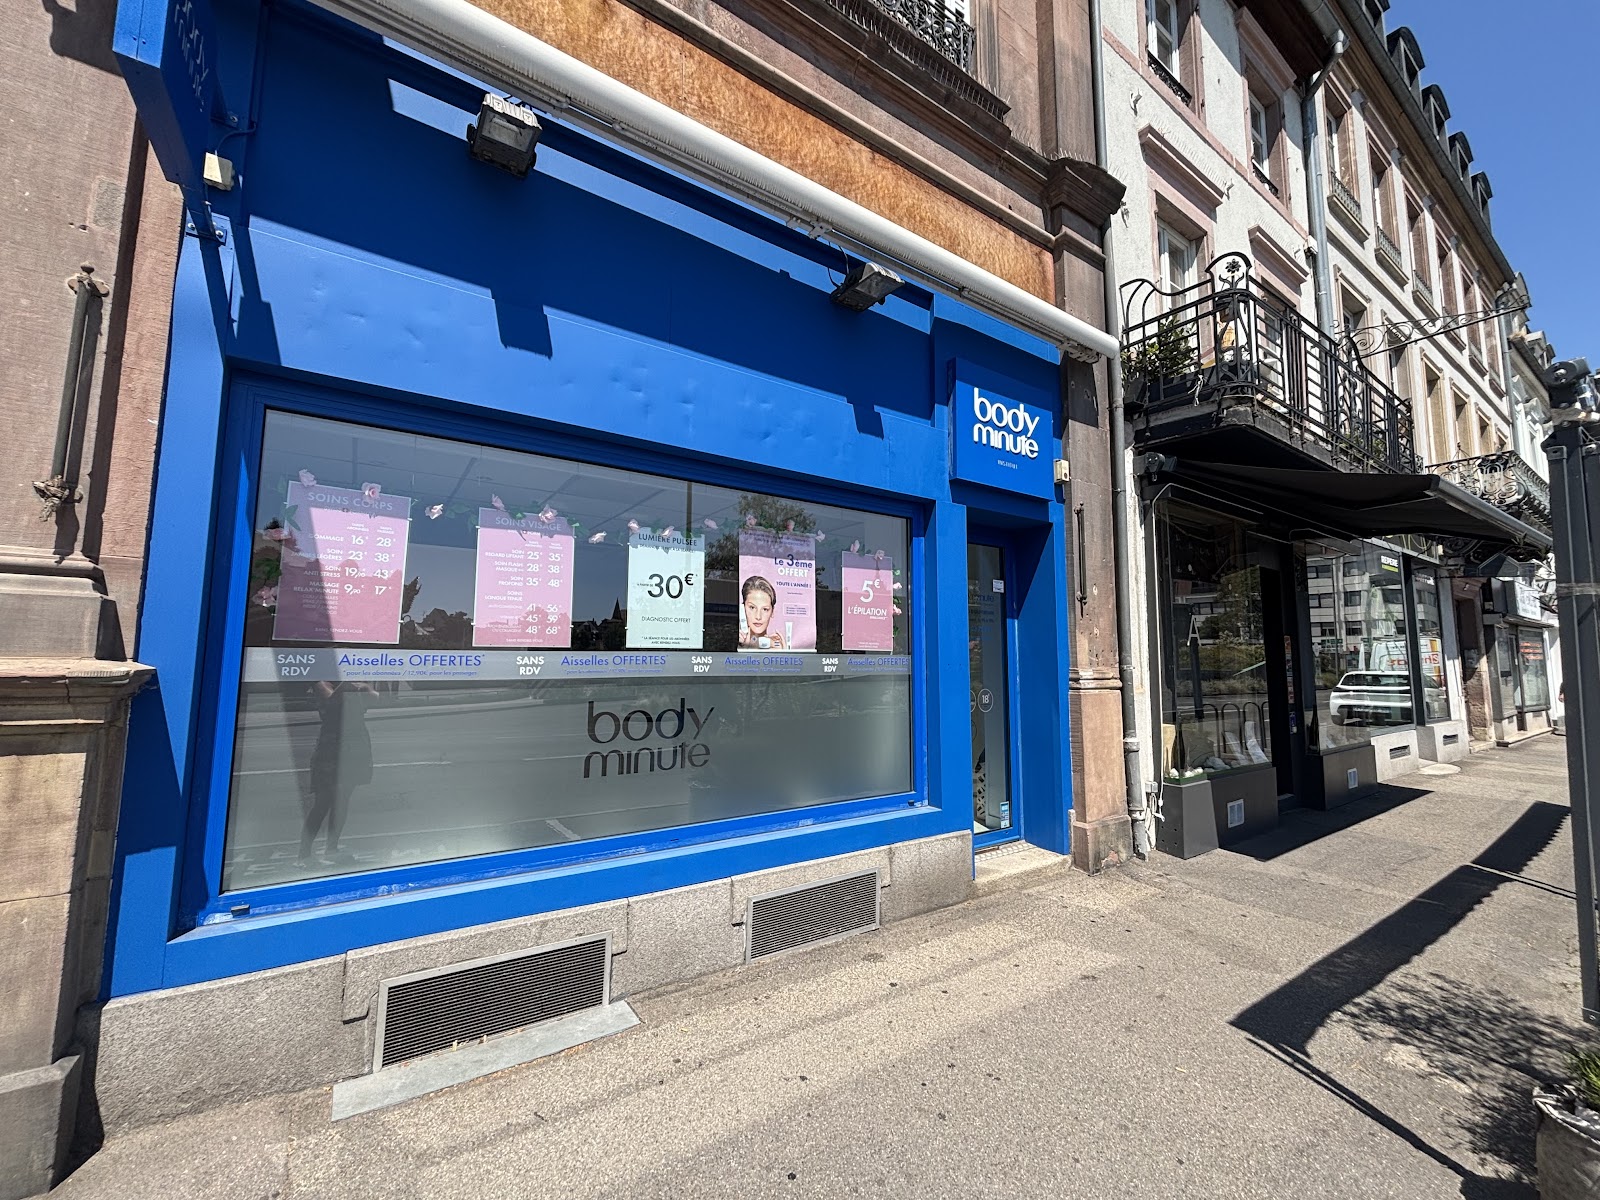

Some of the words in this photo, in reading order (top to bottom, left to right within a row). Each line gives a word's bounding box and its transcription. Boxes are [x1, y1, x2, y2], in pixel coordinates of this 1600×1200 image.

[974, 386, 1040, 438] body
[973, 423, 1038, 458] minute
[308, 492, 349, 505] SOINS
[353, 498, 393, 511] CORPS
[495, 516, 526, 527] SOINS
[528, 520, 562, 531] VISAGE
[638, 533, 670, 544] LUMIÈRE
[774, 556, 784, 566] Le
[778, 568, 808, 578] OFFERT
[848, 605, 887, 616] L'ÉPILATION
[277, 654, 316, 664] SANS
[338, 654, 404, 666] Aisselles
[516, 656, 545, 665] SANS
[561, 655, 609, 666] Aisselles
[691, 656, 712, 664] SANS
[725, 656, 760, 666] Aisselles
[848, 658, 876, 666] Aisselles
[281, 666, 311, 676] RDV
[519, 667, 542, 676] RDV
[588, 698, 715, 744] body
[584, 742, 711, 778] minute
